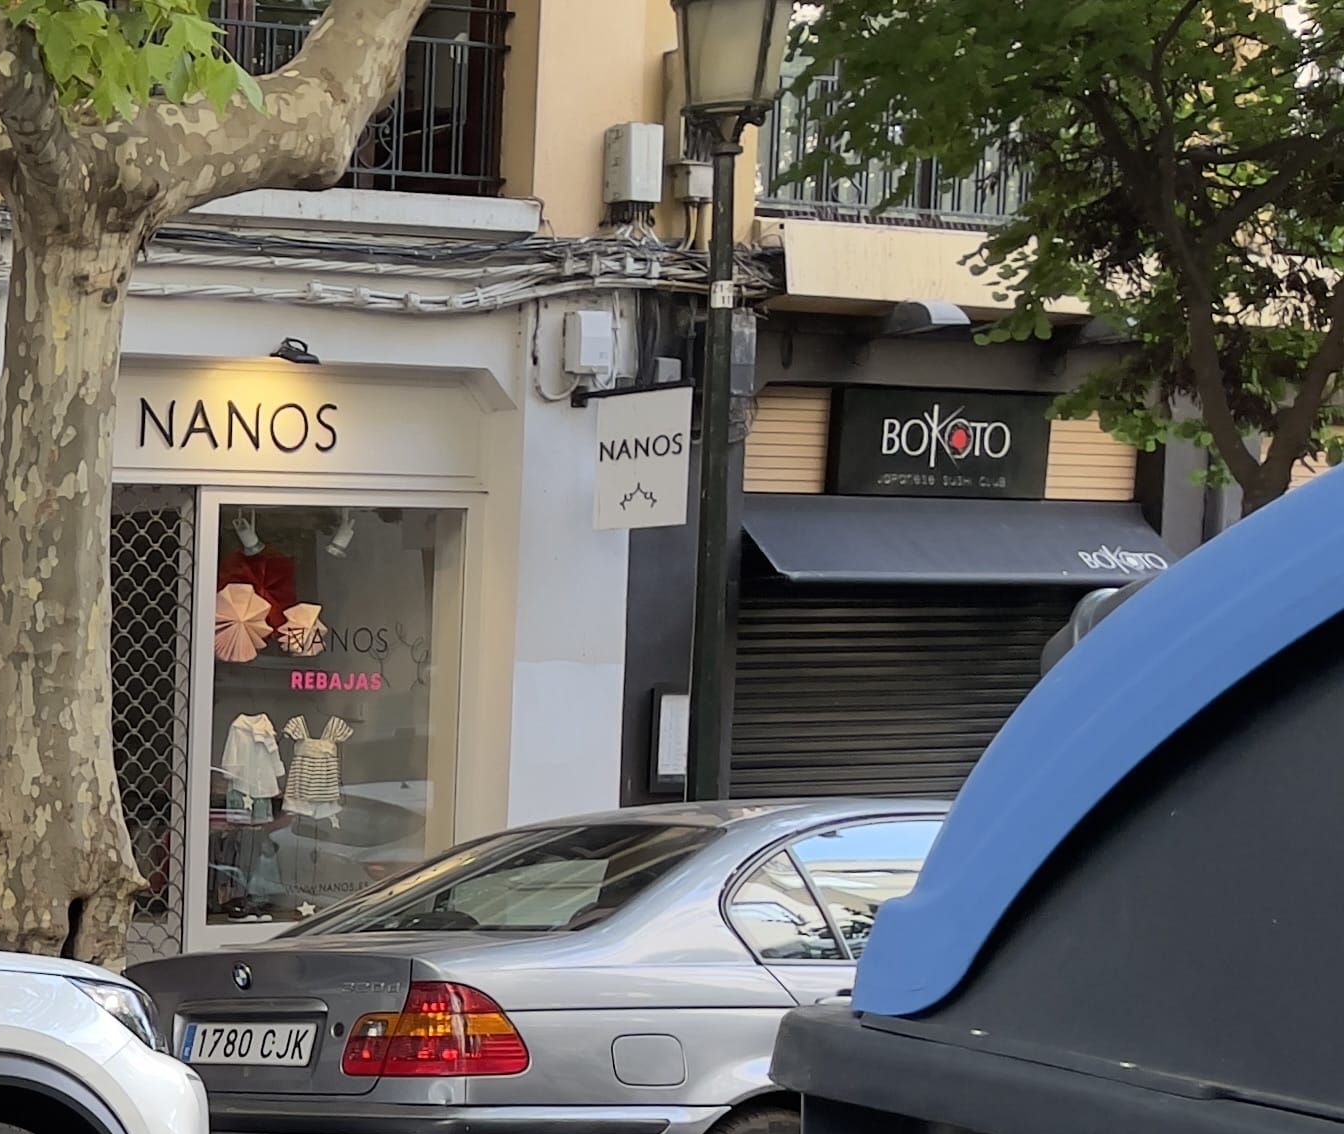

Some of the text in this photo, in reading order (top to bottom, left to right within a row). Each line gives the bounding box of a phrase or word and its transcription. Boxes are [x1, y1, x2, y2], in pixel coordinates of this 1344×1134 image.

[139, 397, 338, 453] NANOS
[880, 403, 1012, 470] BOKOTO
[599, 432, 683, 463] NANOS
[1077, 544, 1169, 575] BOKOTO
[287, 627, 389, 654] NANOS
[290, 670, 383, 691] REBAJAS
[197, 1027, 310, 1060] 1780 CJK
